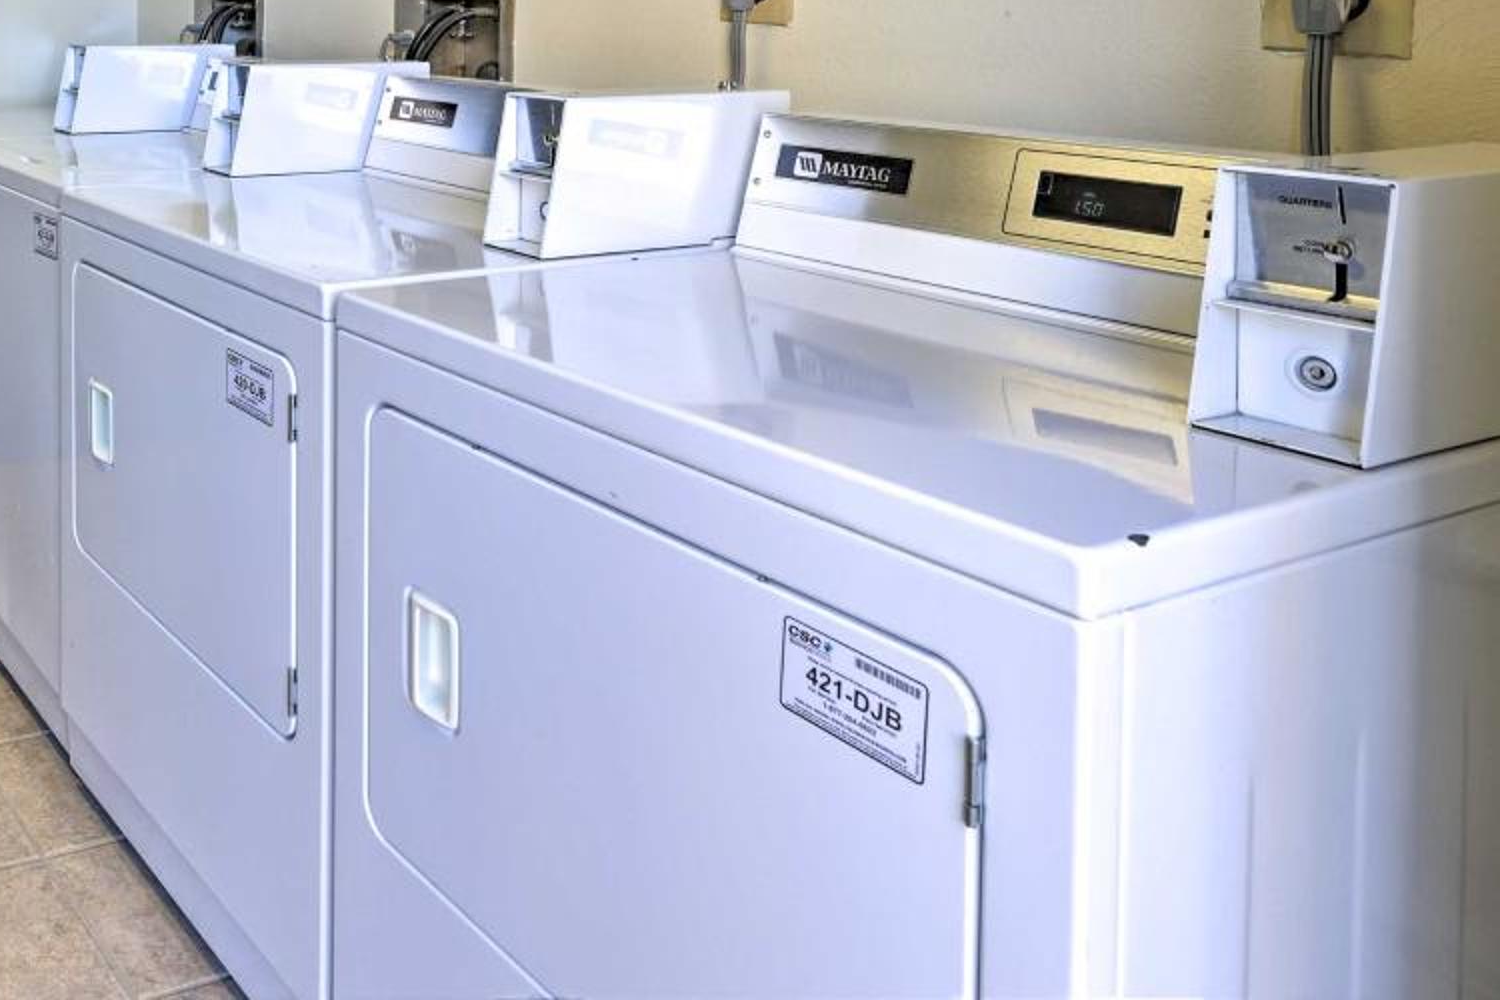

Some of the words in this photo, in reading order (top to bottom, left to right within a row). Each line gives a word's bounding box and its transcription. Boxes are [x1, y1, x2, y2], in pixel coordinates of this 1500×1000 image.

[822, 160, 891, 183] MAYTAG
[1278, 194, 1333, 209] QUARTERS
[788, 625, 822, 649] CSC
[805, 666, 902, 732] 421-DJB
